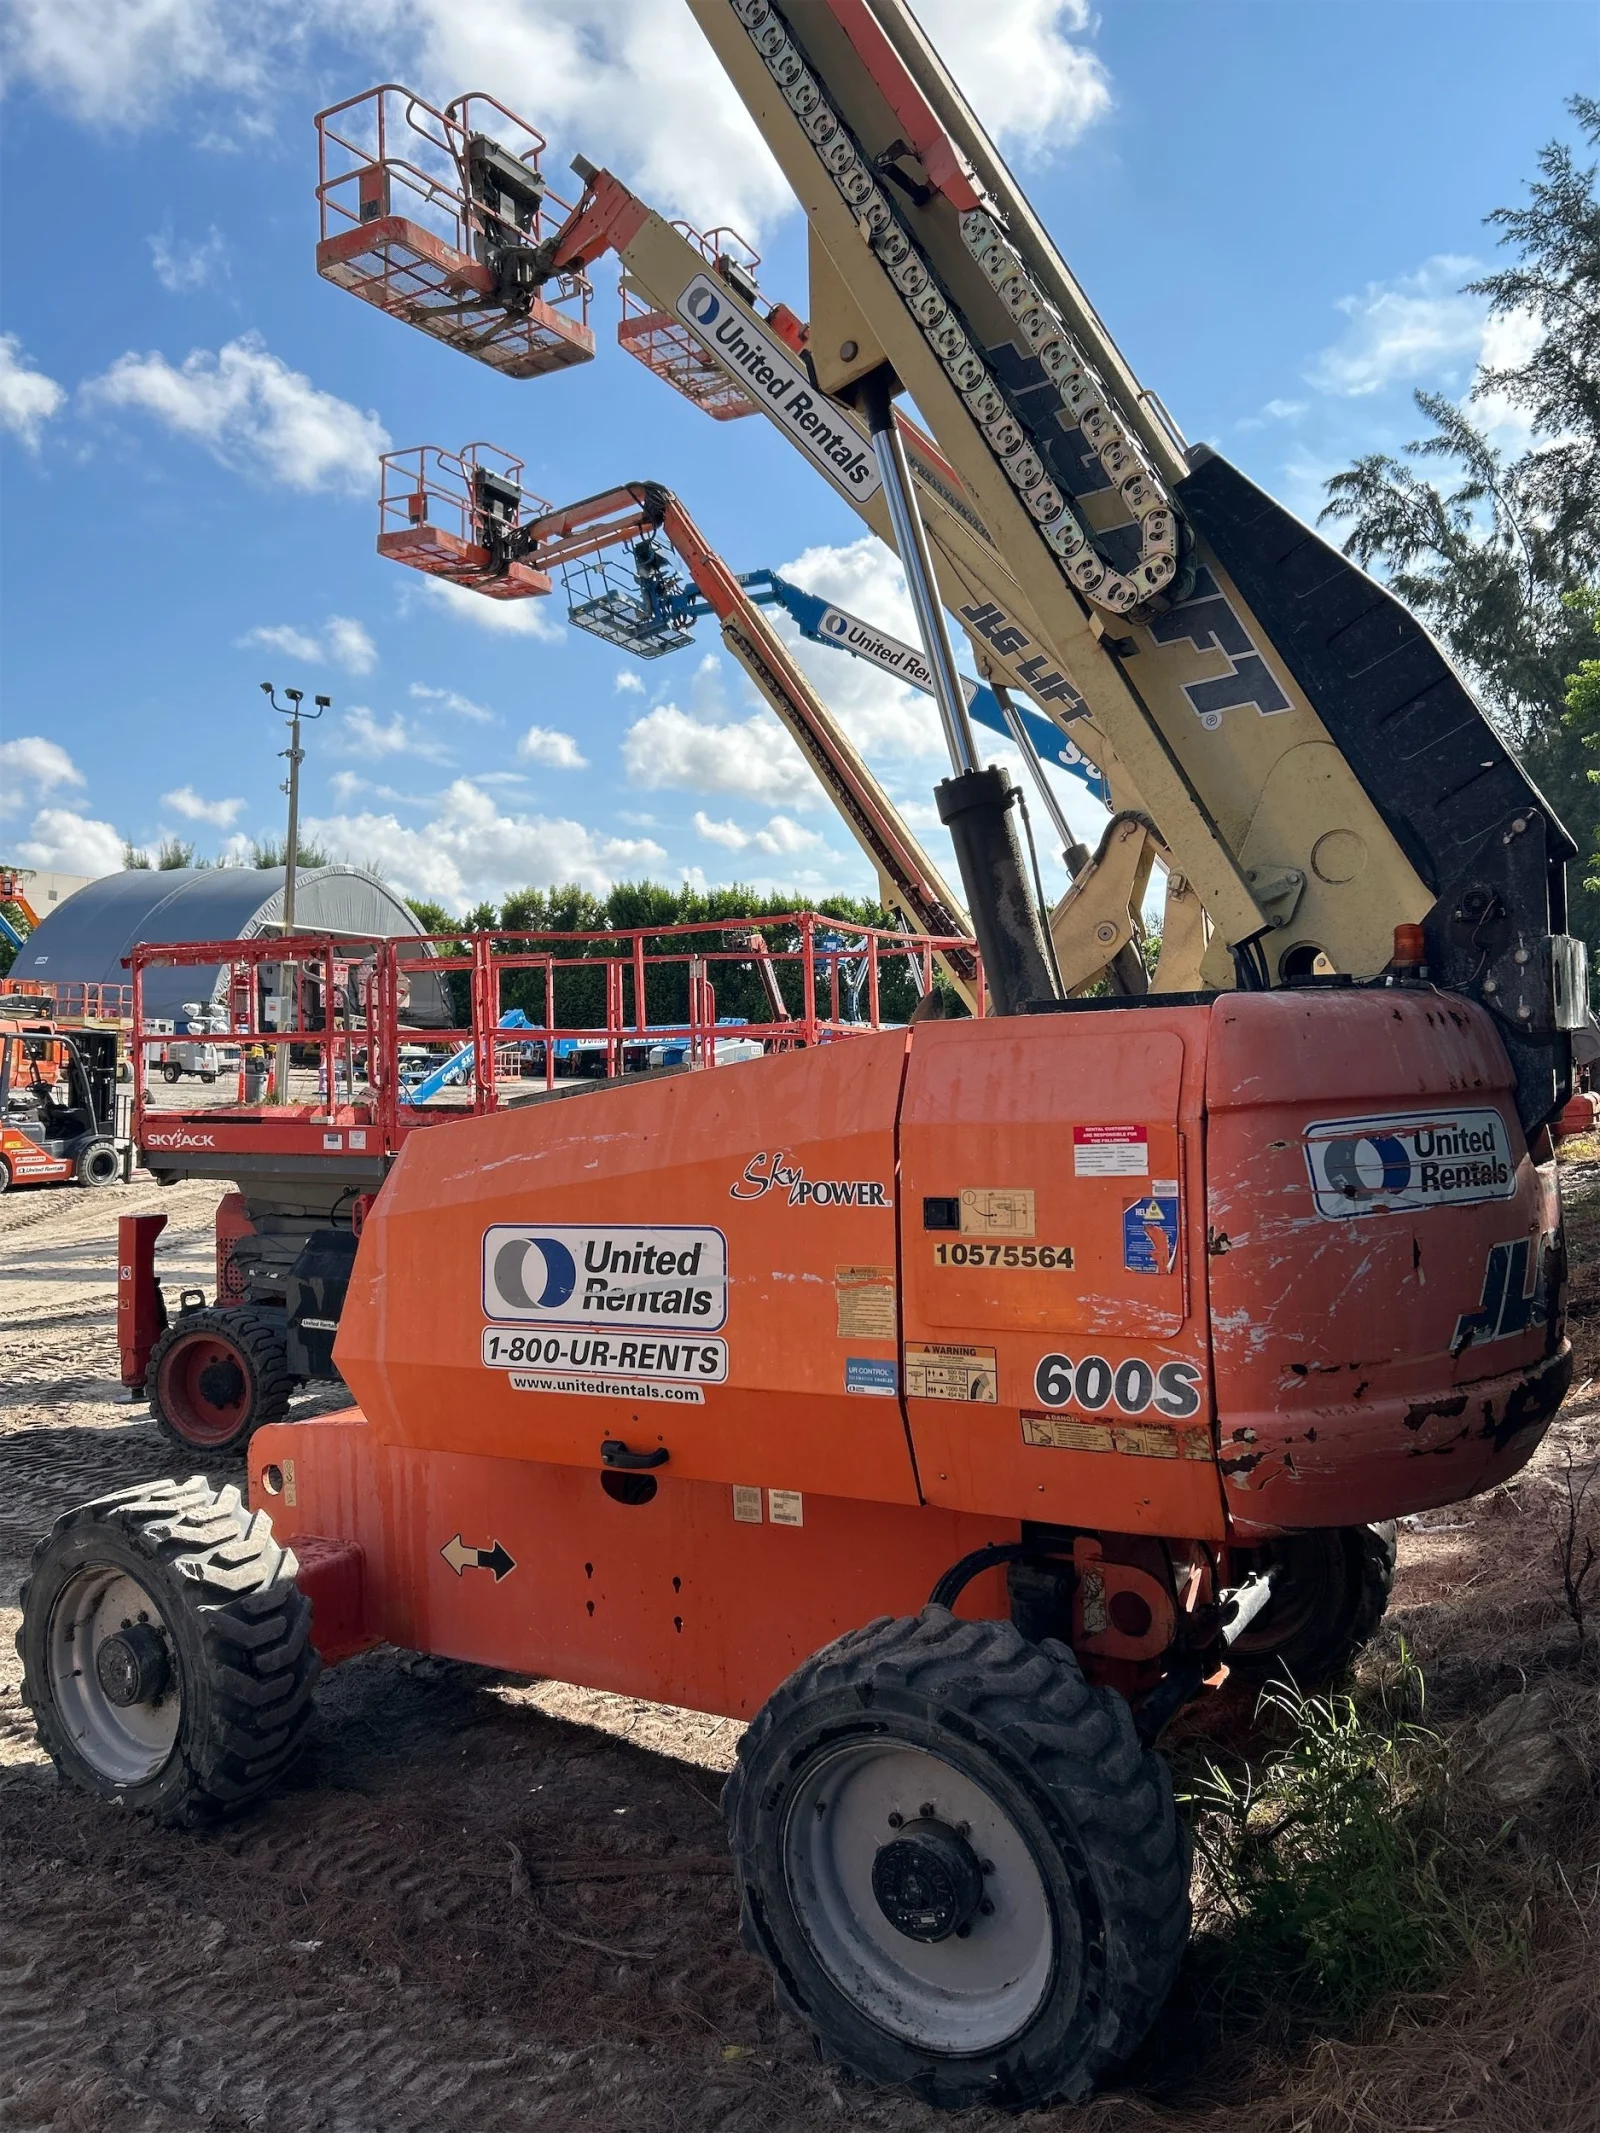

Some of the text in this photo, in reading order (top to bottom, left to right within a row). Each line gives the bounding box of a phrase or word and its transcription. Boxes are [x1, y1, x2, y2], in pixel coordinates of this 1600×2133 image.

[715, 316, 870, 484] United Rentals
[848, 626, 905, 666] United
[958, 601, 1094, 723] JLG LIFT
[147, 1128, 215, 1148] SKYJACK
[1413, 1123, 1496, 1158] United
[1420, 1158, 1508, 1193] Rentals
[584, 1241, 702, 1276] United
[936, 1243, 1074, 1269] 10575564
[582, 1277, 713, 1316] Rentals
[488, 1336, 719, 1374] 1-800-UR-RENTS
[932, 1345, 977, 1356] WARNING
[513, 1376, 700, 1402] www.unitedrentals.com
[858, 1367, 889, 1376] CONTROL
[1036, 1354, 1201, 1418] 600S
